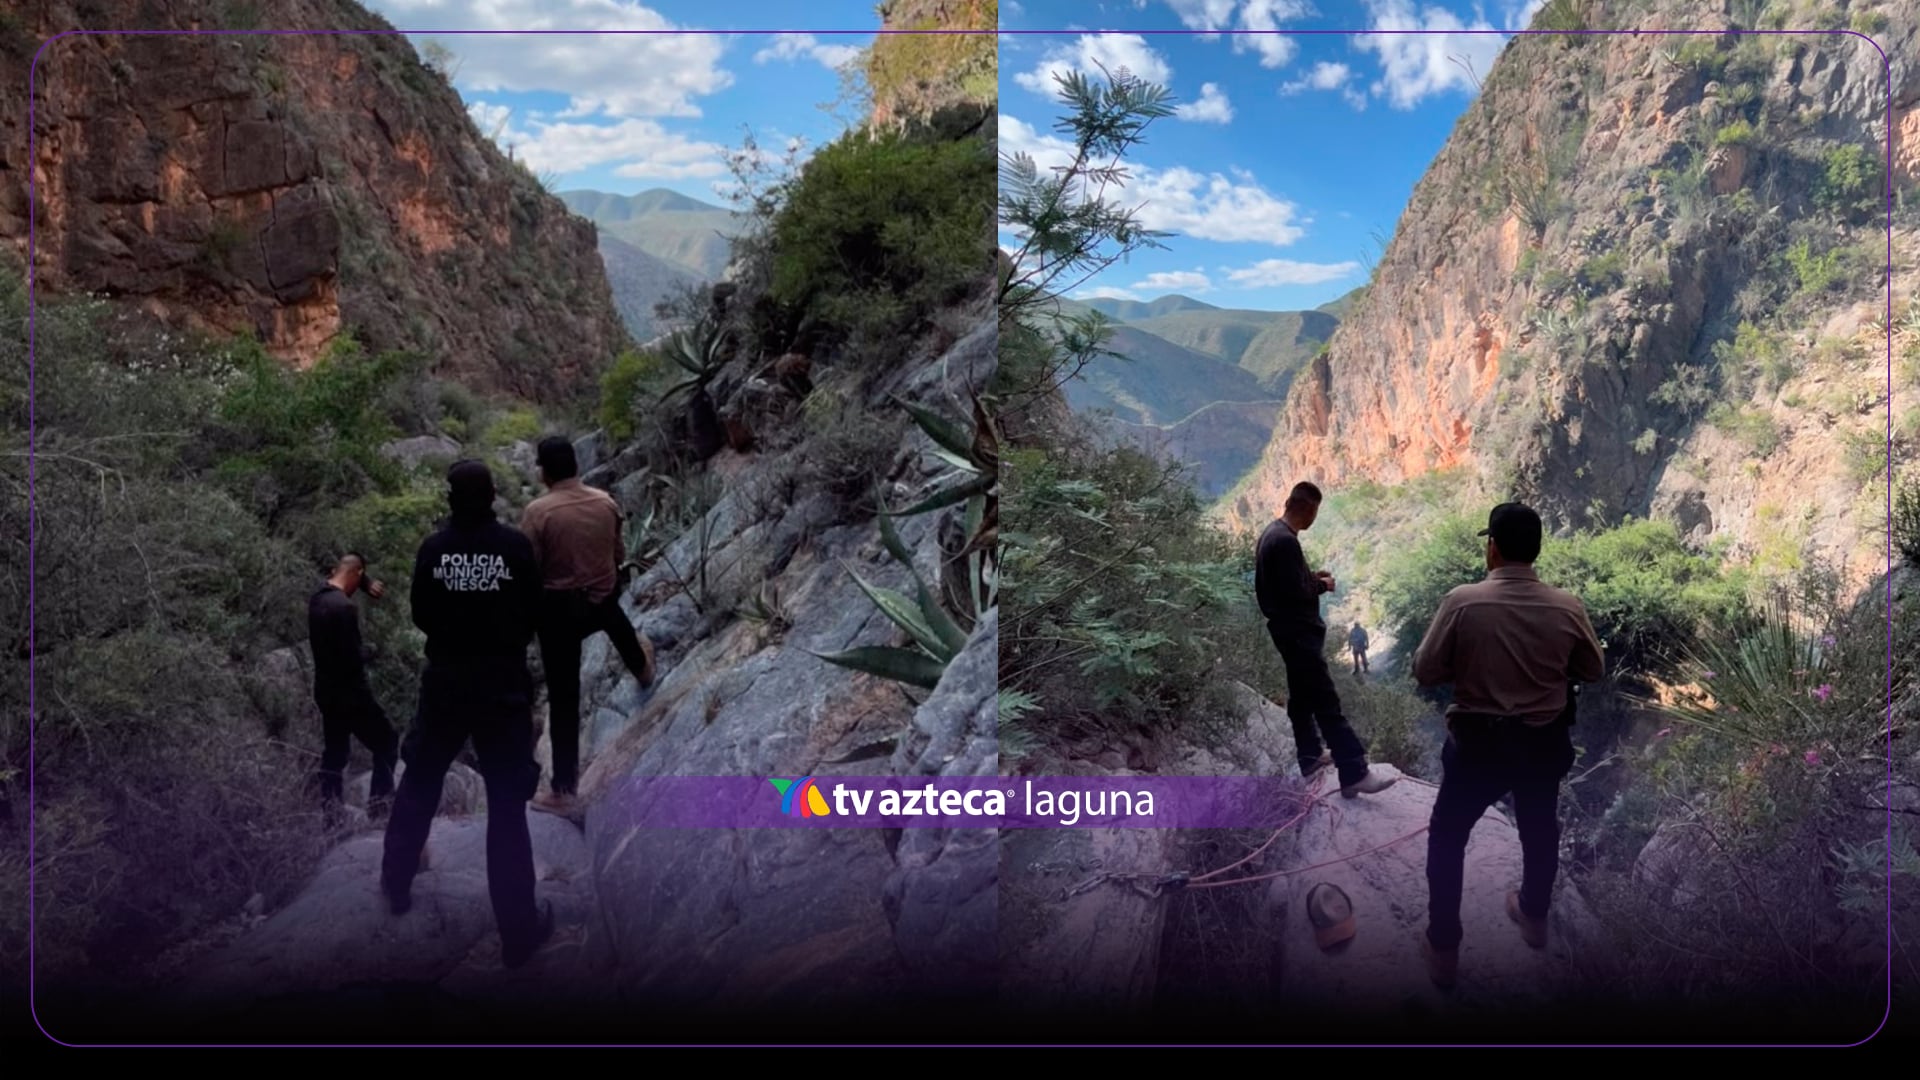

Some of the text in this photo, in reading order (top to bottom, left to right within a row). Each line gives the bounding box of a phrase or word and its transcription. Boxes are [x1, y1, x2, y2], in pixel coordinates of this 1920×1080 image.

[441, 553, 504, 566] POLICIA
[433, 566, 513, 580] MUNICIPAL
[444, 579, 501, 591] VIESCA
